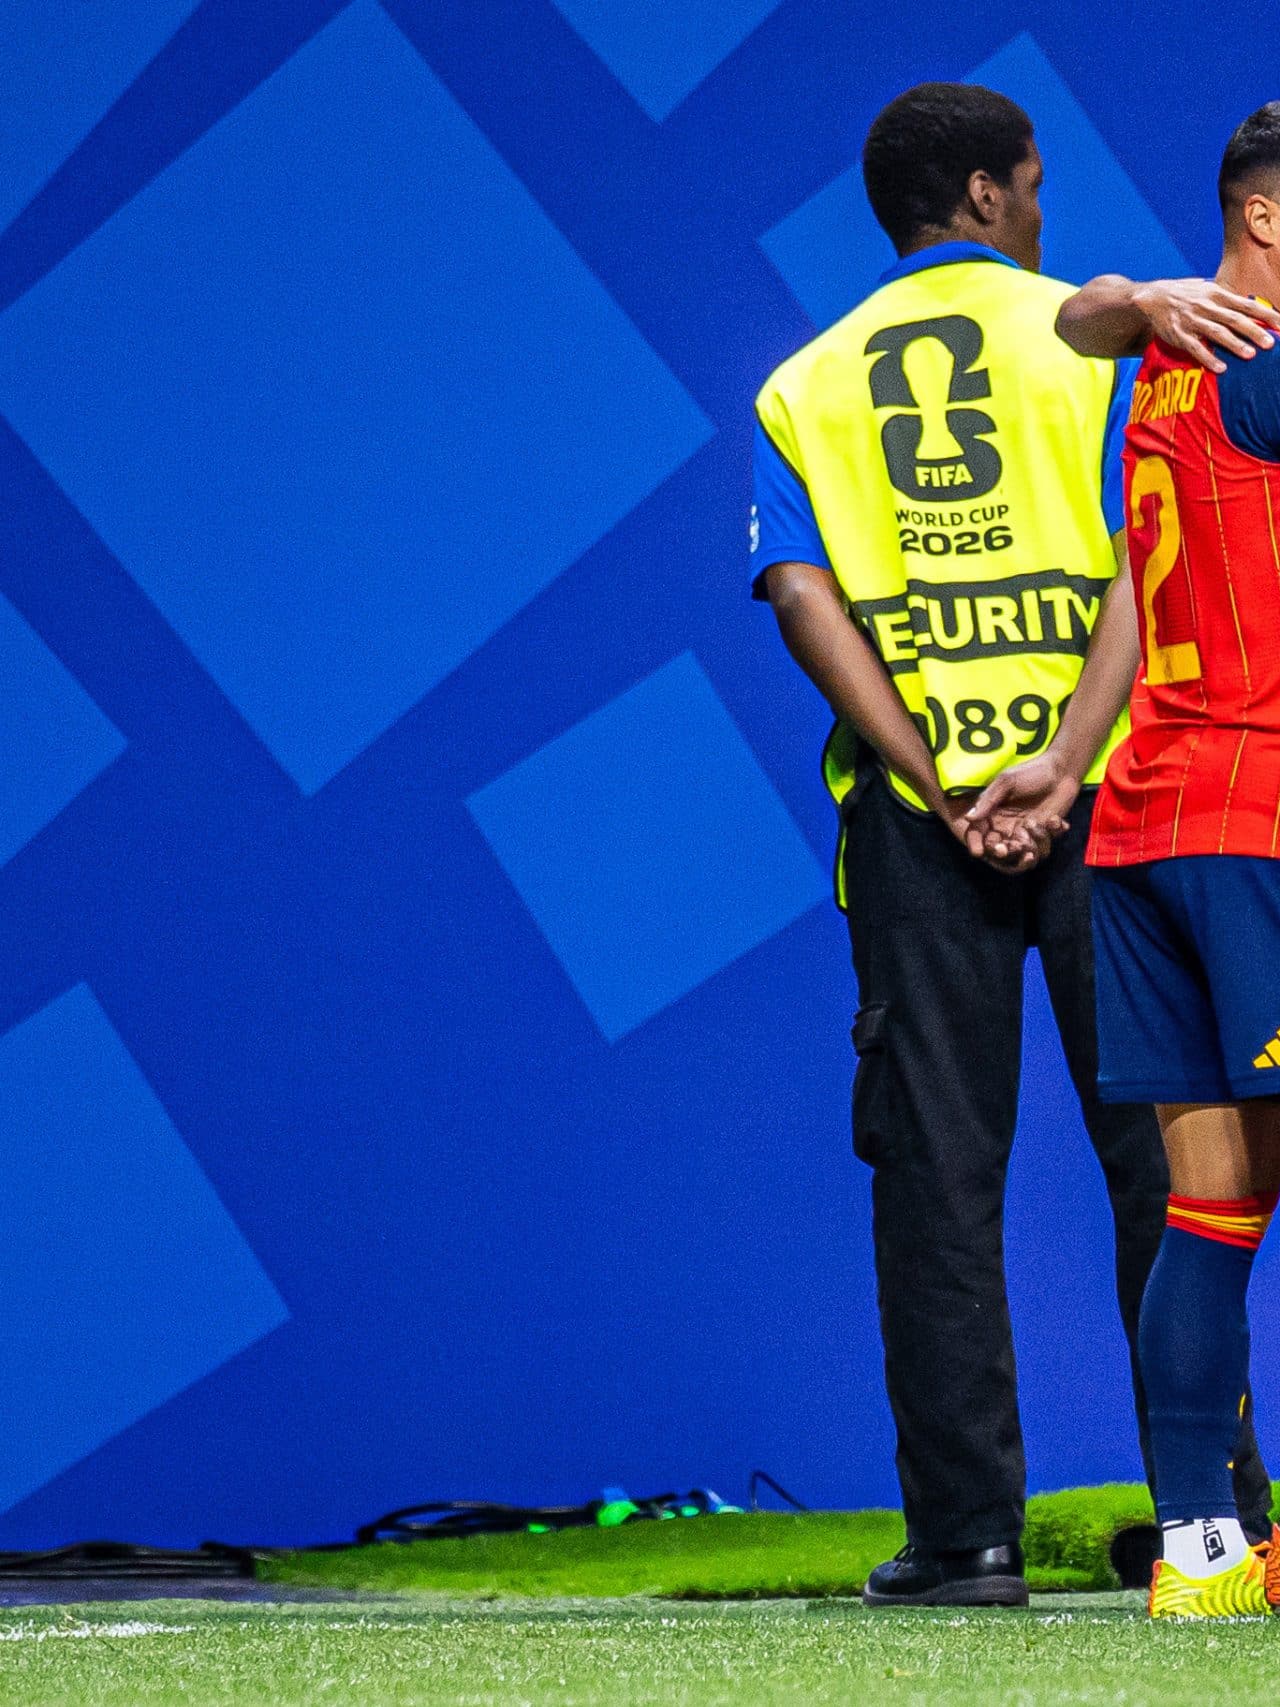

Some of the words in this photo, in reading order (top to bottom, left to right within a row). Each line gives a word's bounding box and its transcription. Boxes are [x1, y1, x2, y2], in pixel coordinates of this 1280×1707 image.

[915, 463, 974, 487] FIFA
[895, 508, 963, 526] WORLD
[969, 504, 1009, 522] CUP
[899, 526, 1013, 556] 2026
